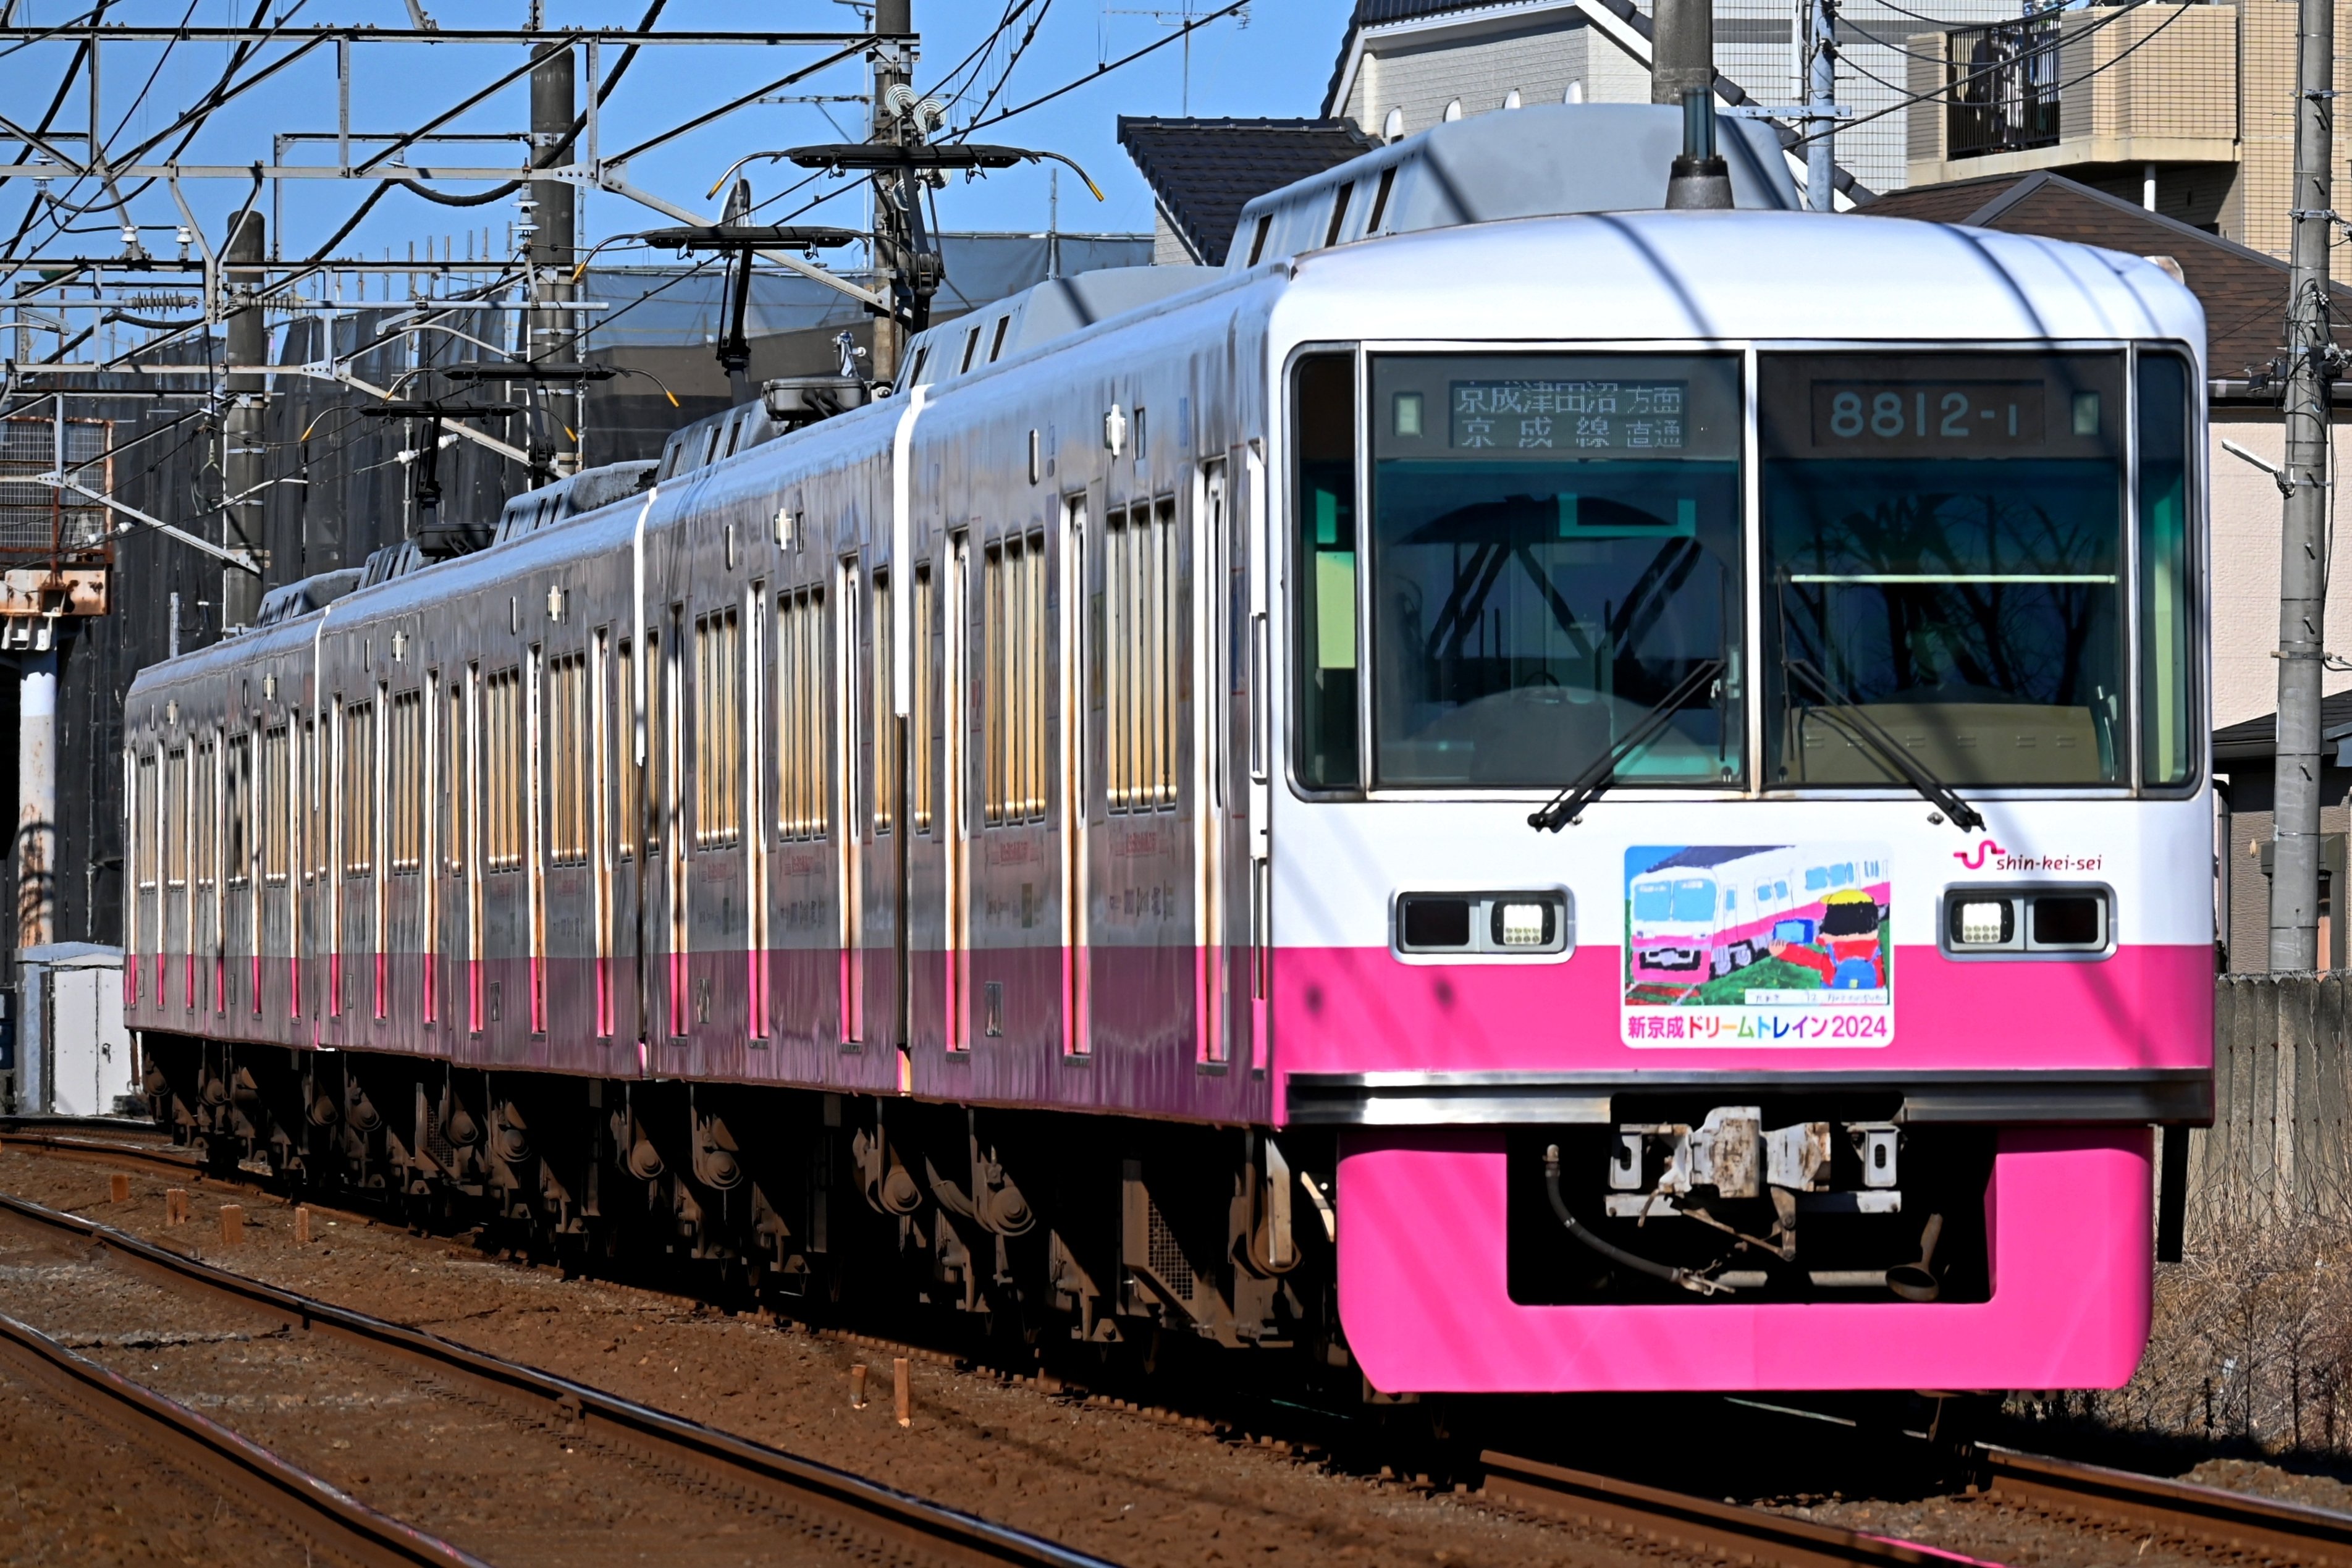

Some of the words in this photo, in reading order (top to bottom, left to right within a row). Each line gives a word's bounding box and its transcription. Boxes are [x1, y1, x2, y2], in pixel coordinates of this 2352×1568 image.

[1830, 392, 2017, 437] 8812-1
[1996, 855, 2102, 870] shin-kei-sei
[1628, 1016, 1887, 1039] 新京成ドリームトレイン2024
